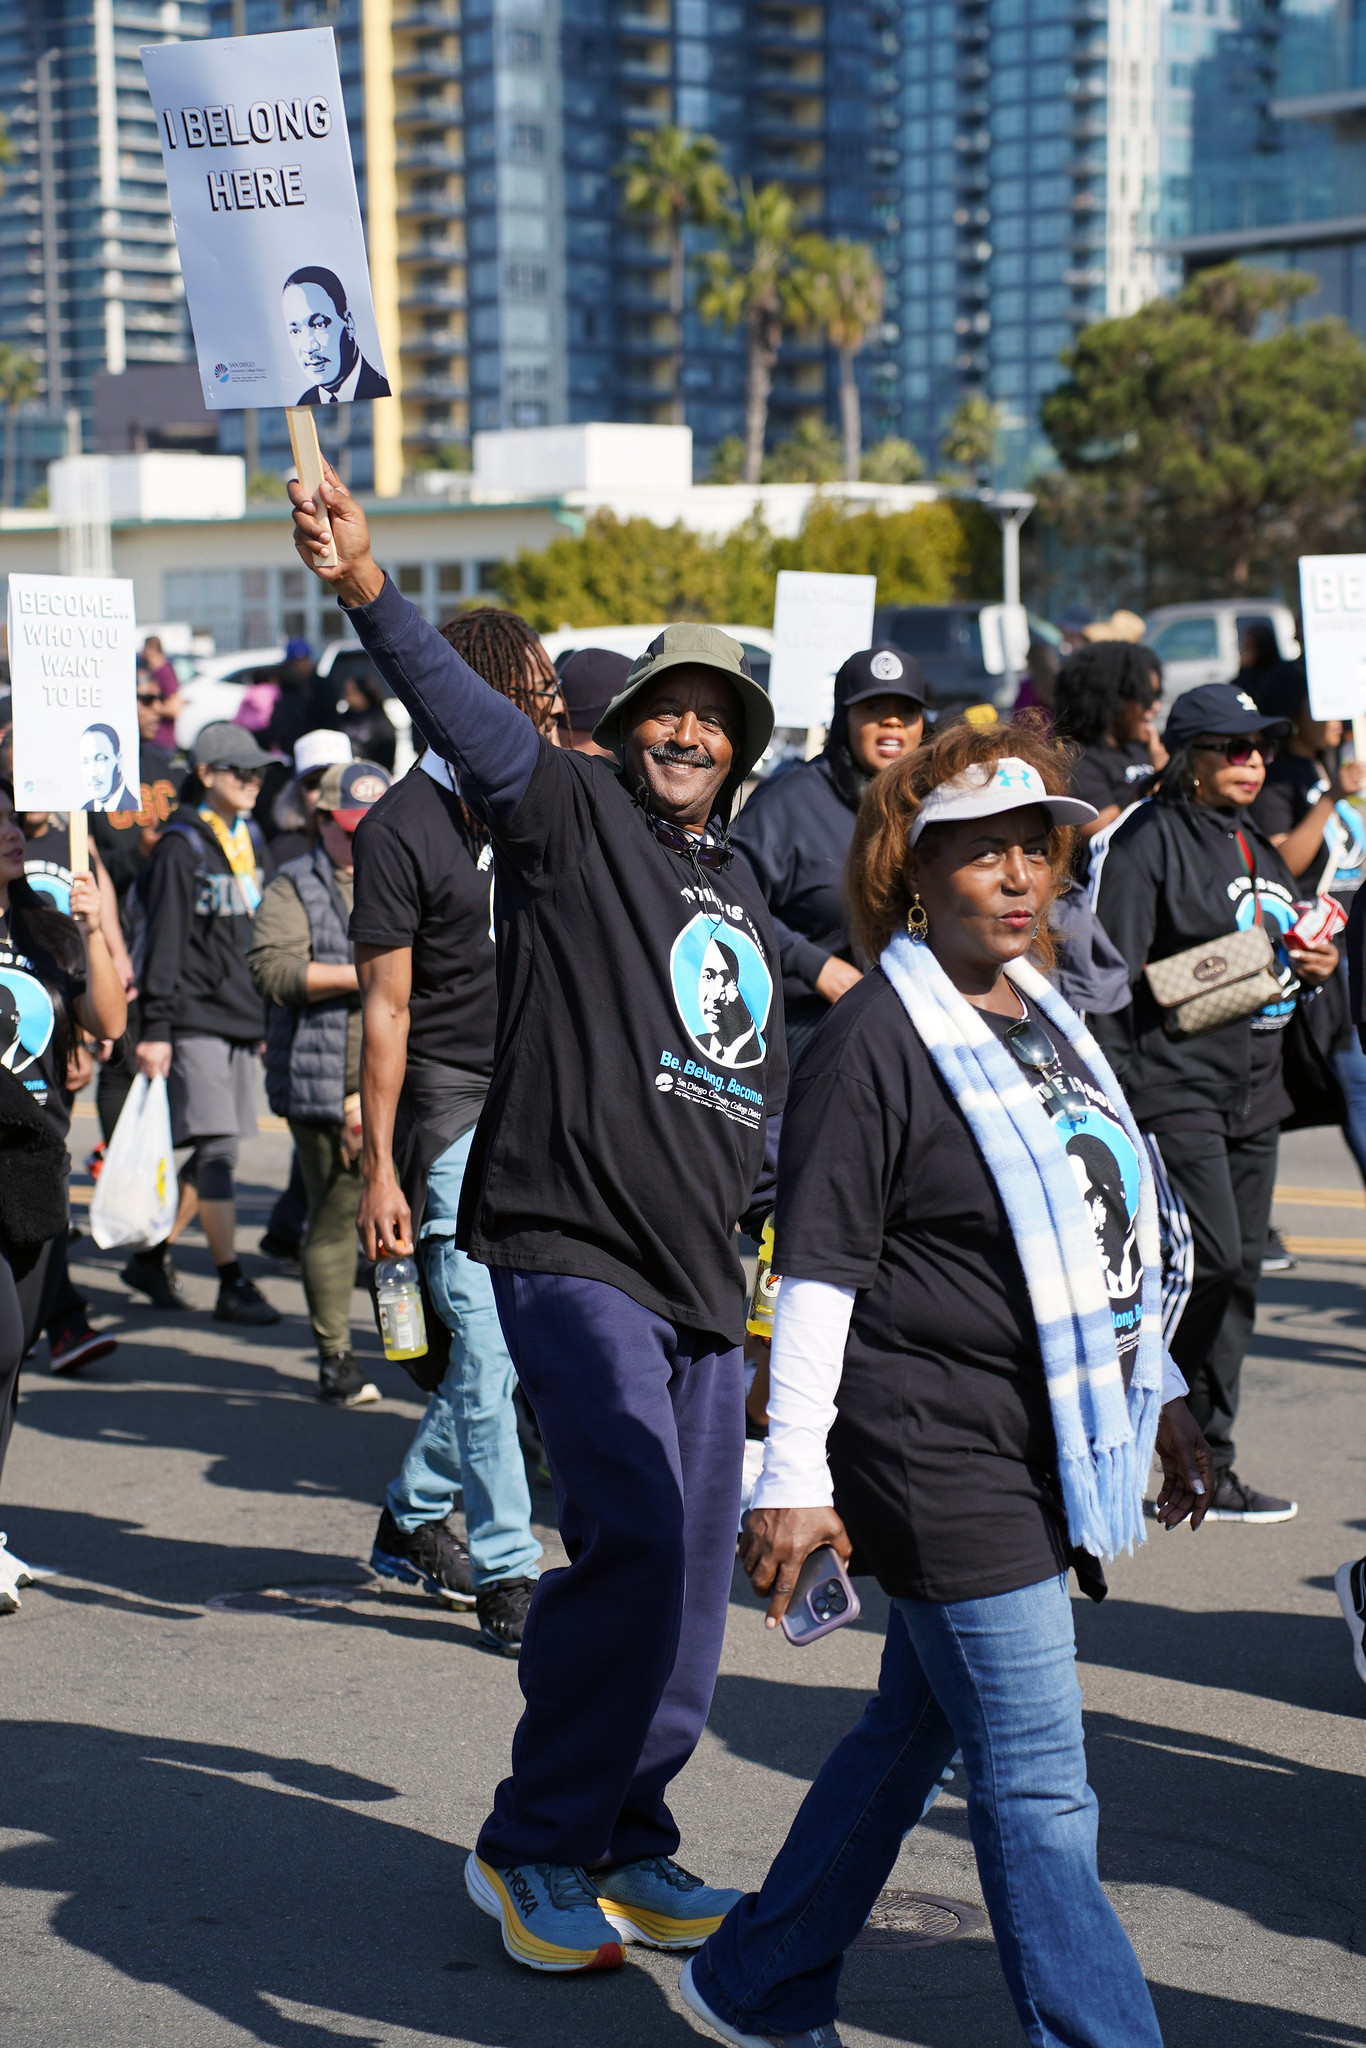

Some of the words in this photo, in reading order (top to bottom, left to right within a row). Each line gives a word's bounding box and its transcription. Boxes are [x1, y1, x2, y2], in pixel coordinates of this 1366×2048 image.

[164, 109, 178, 149] I
[181, 96, 332, 148] BELONG
[207, 164, 307, 211] HERE
[19, 590, 129, 619] BECOME...
[23, 623, 73, 648] WHO
[78, 626, 119, 650] YOU
[41, 655, 104, 678] WANT
[42, 685, 69, 707] TO
[76, 686, 103, 708] BE
[725, 904, 744, 921] IS
[660, 1050, 681, 1071] Be.
[726, 1077, 764, 1106] Become.
[687, 1081, 708, 1096] Diego
[1111, 1310, 1135, 1330] long.
[505, 1866, 539, 1919] HOKA
